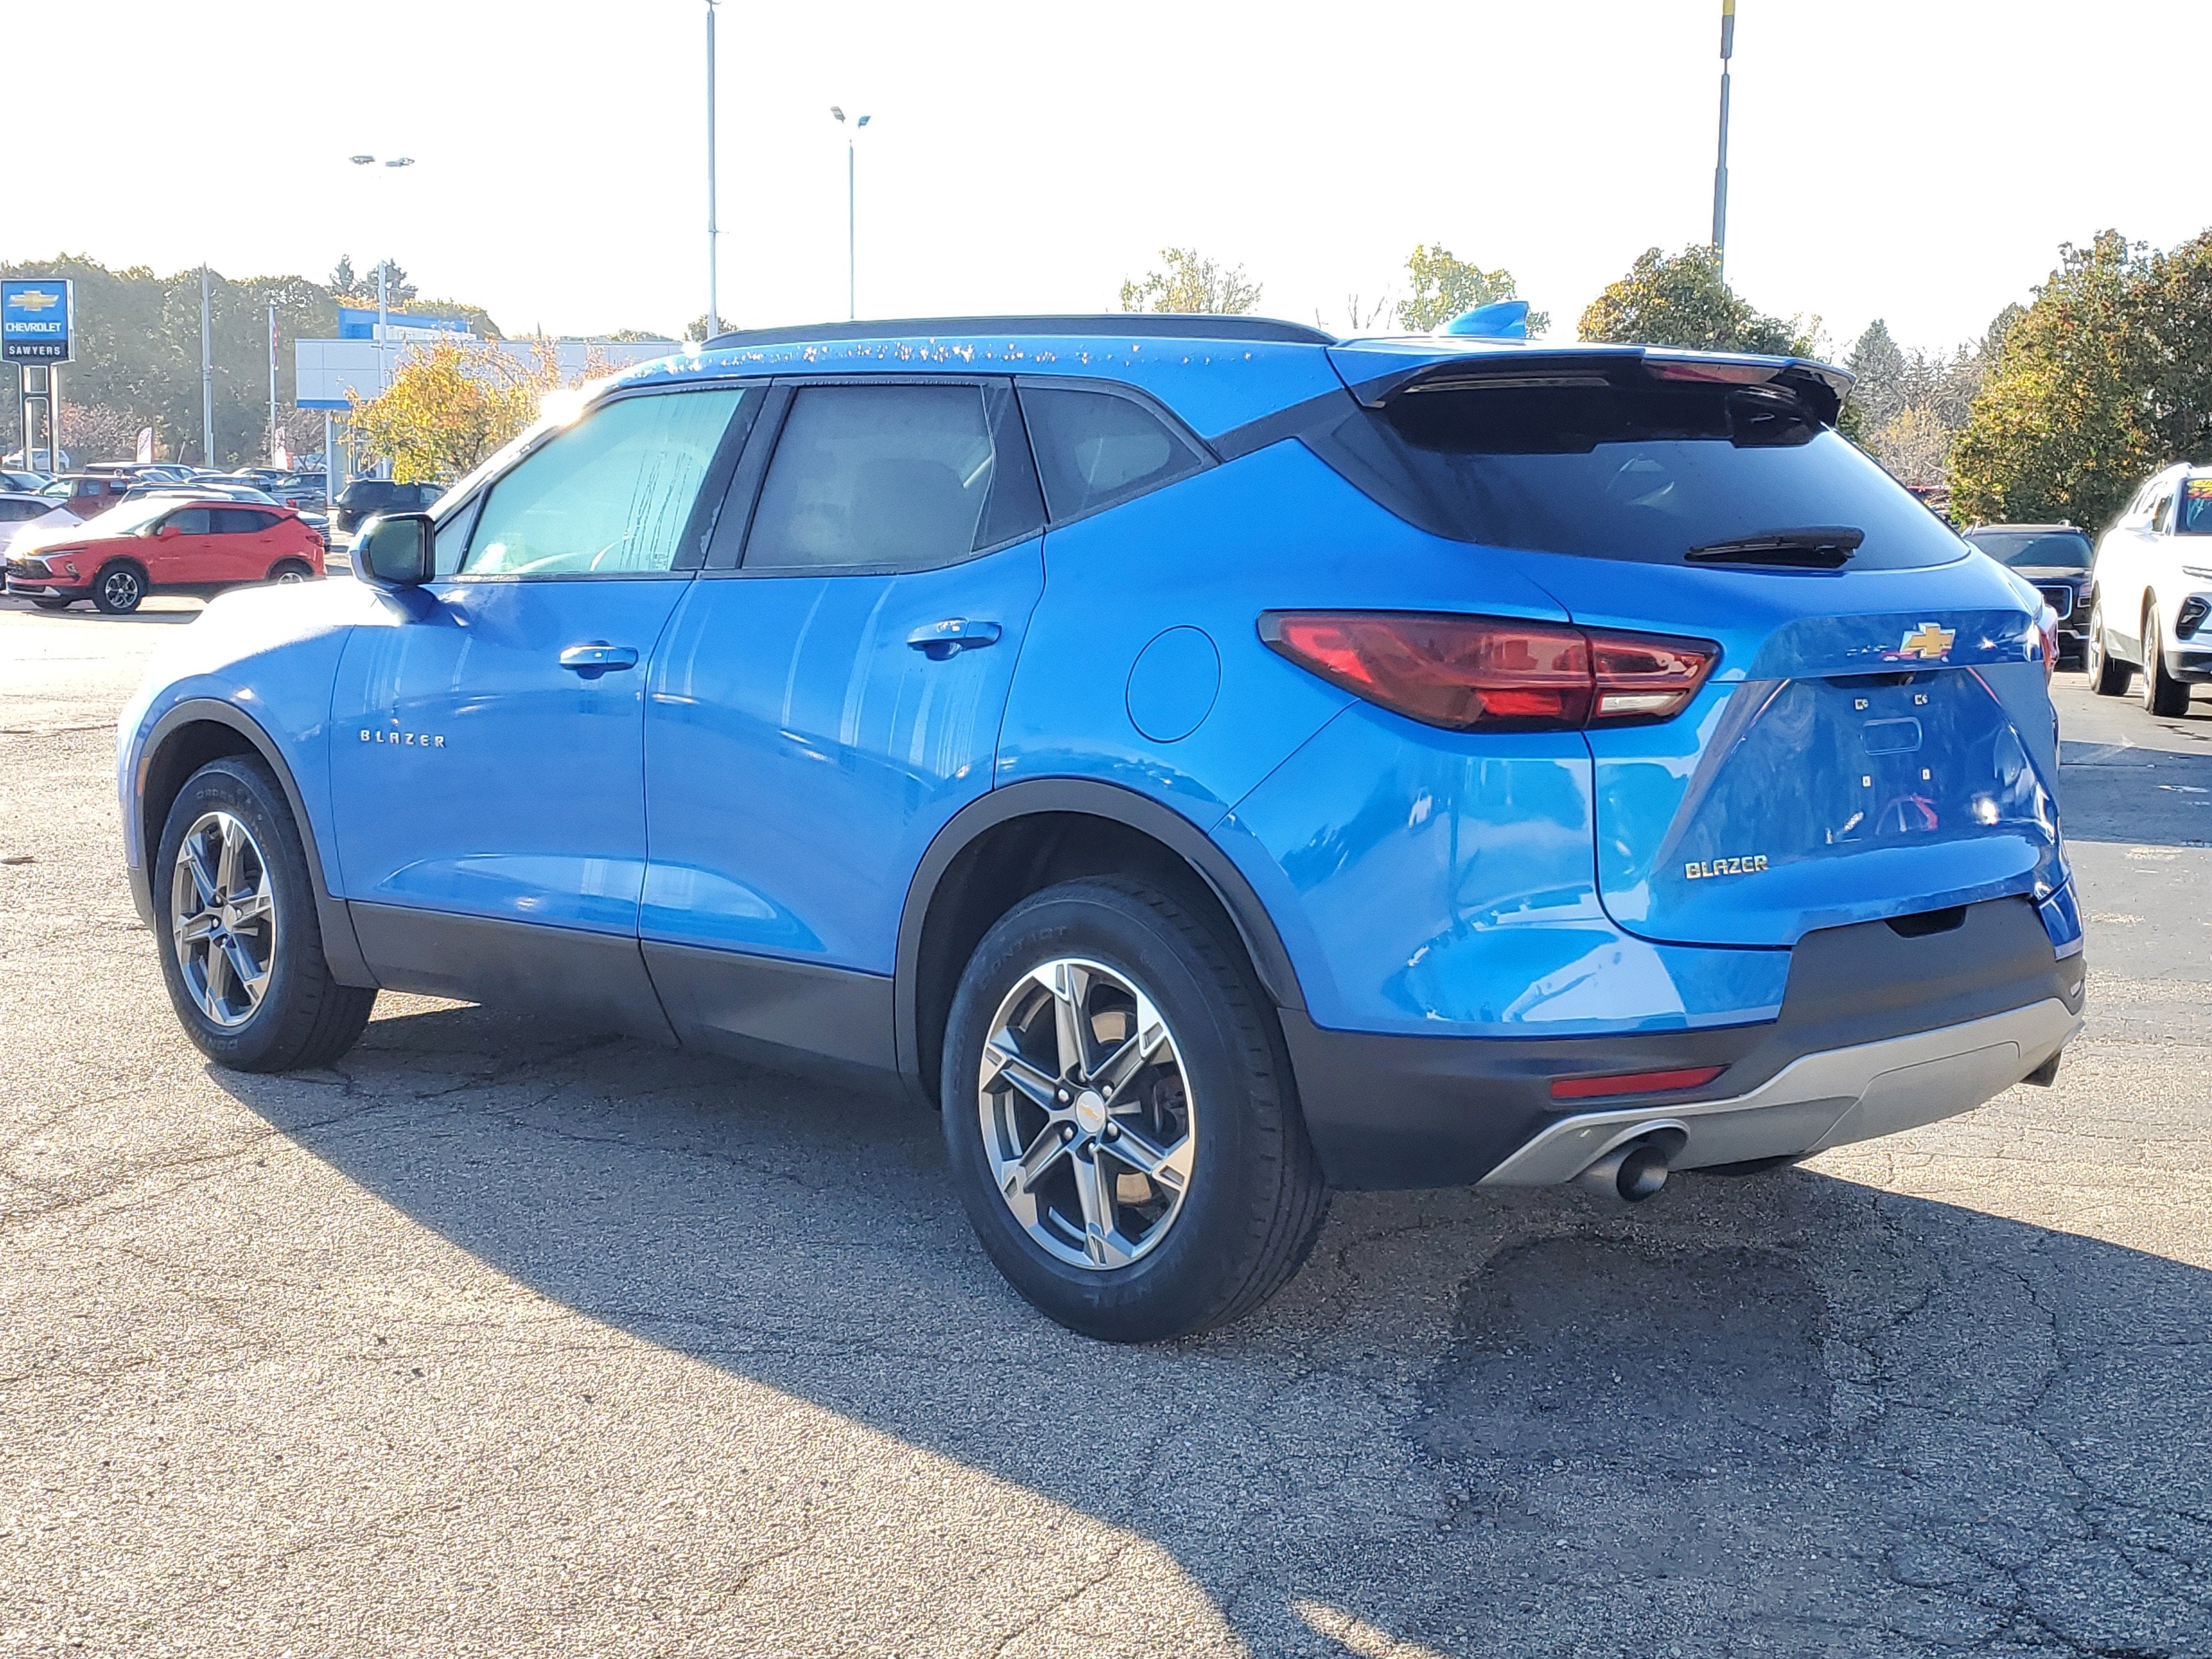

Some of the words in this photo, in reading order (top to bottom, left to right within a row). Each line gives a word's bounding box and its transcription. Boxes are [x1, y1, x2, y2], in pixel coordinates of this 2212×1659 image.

[5, 322, 61, 332] CHEVROLET
[9, 345, 61, 356] SAWYERS
[360, 730, 445, 748] BLAZER
[1685, 854, 1769, 879] BLAZER
